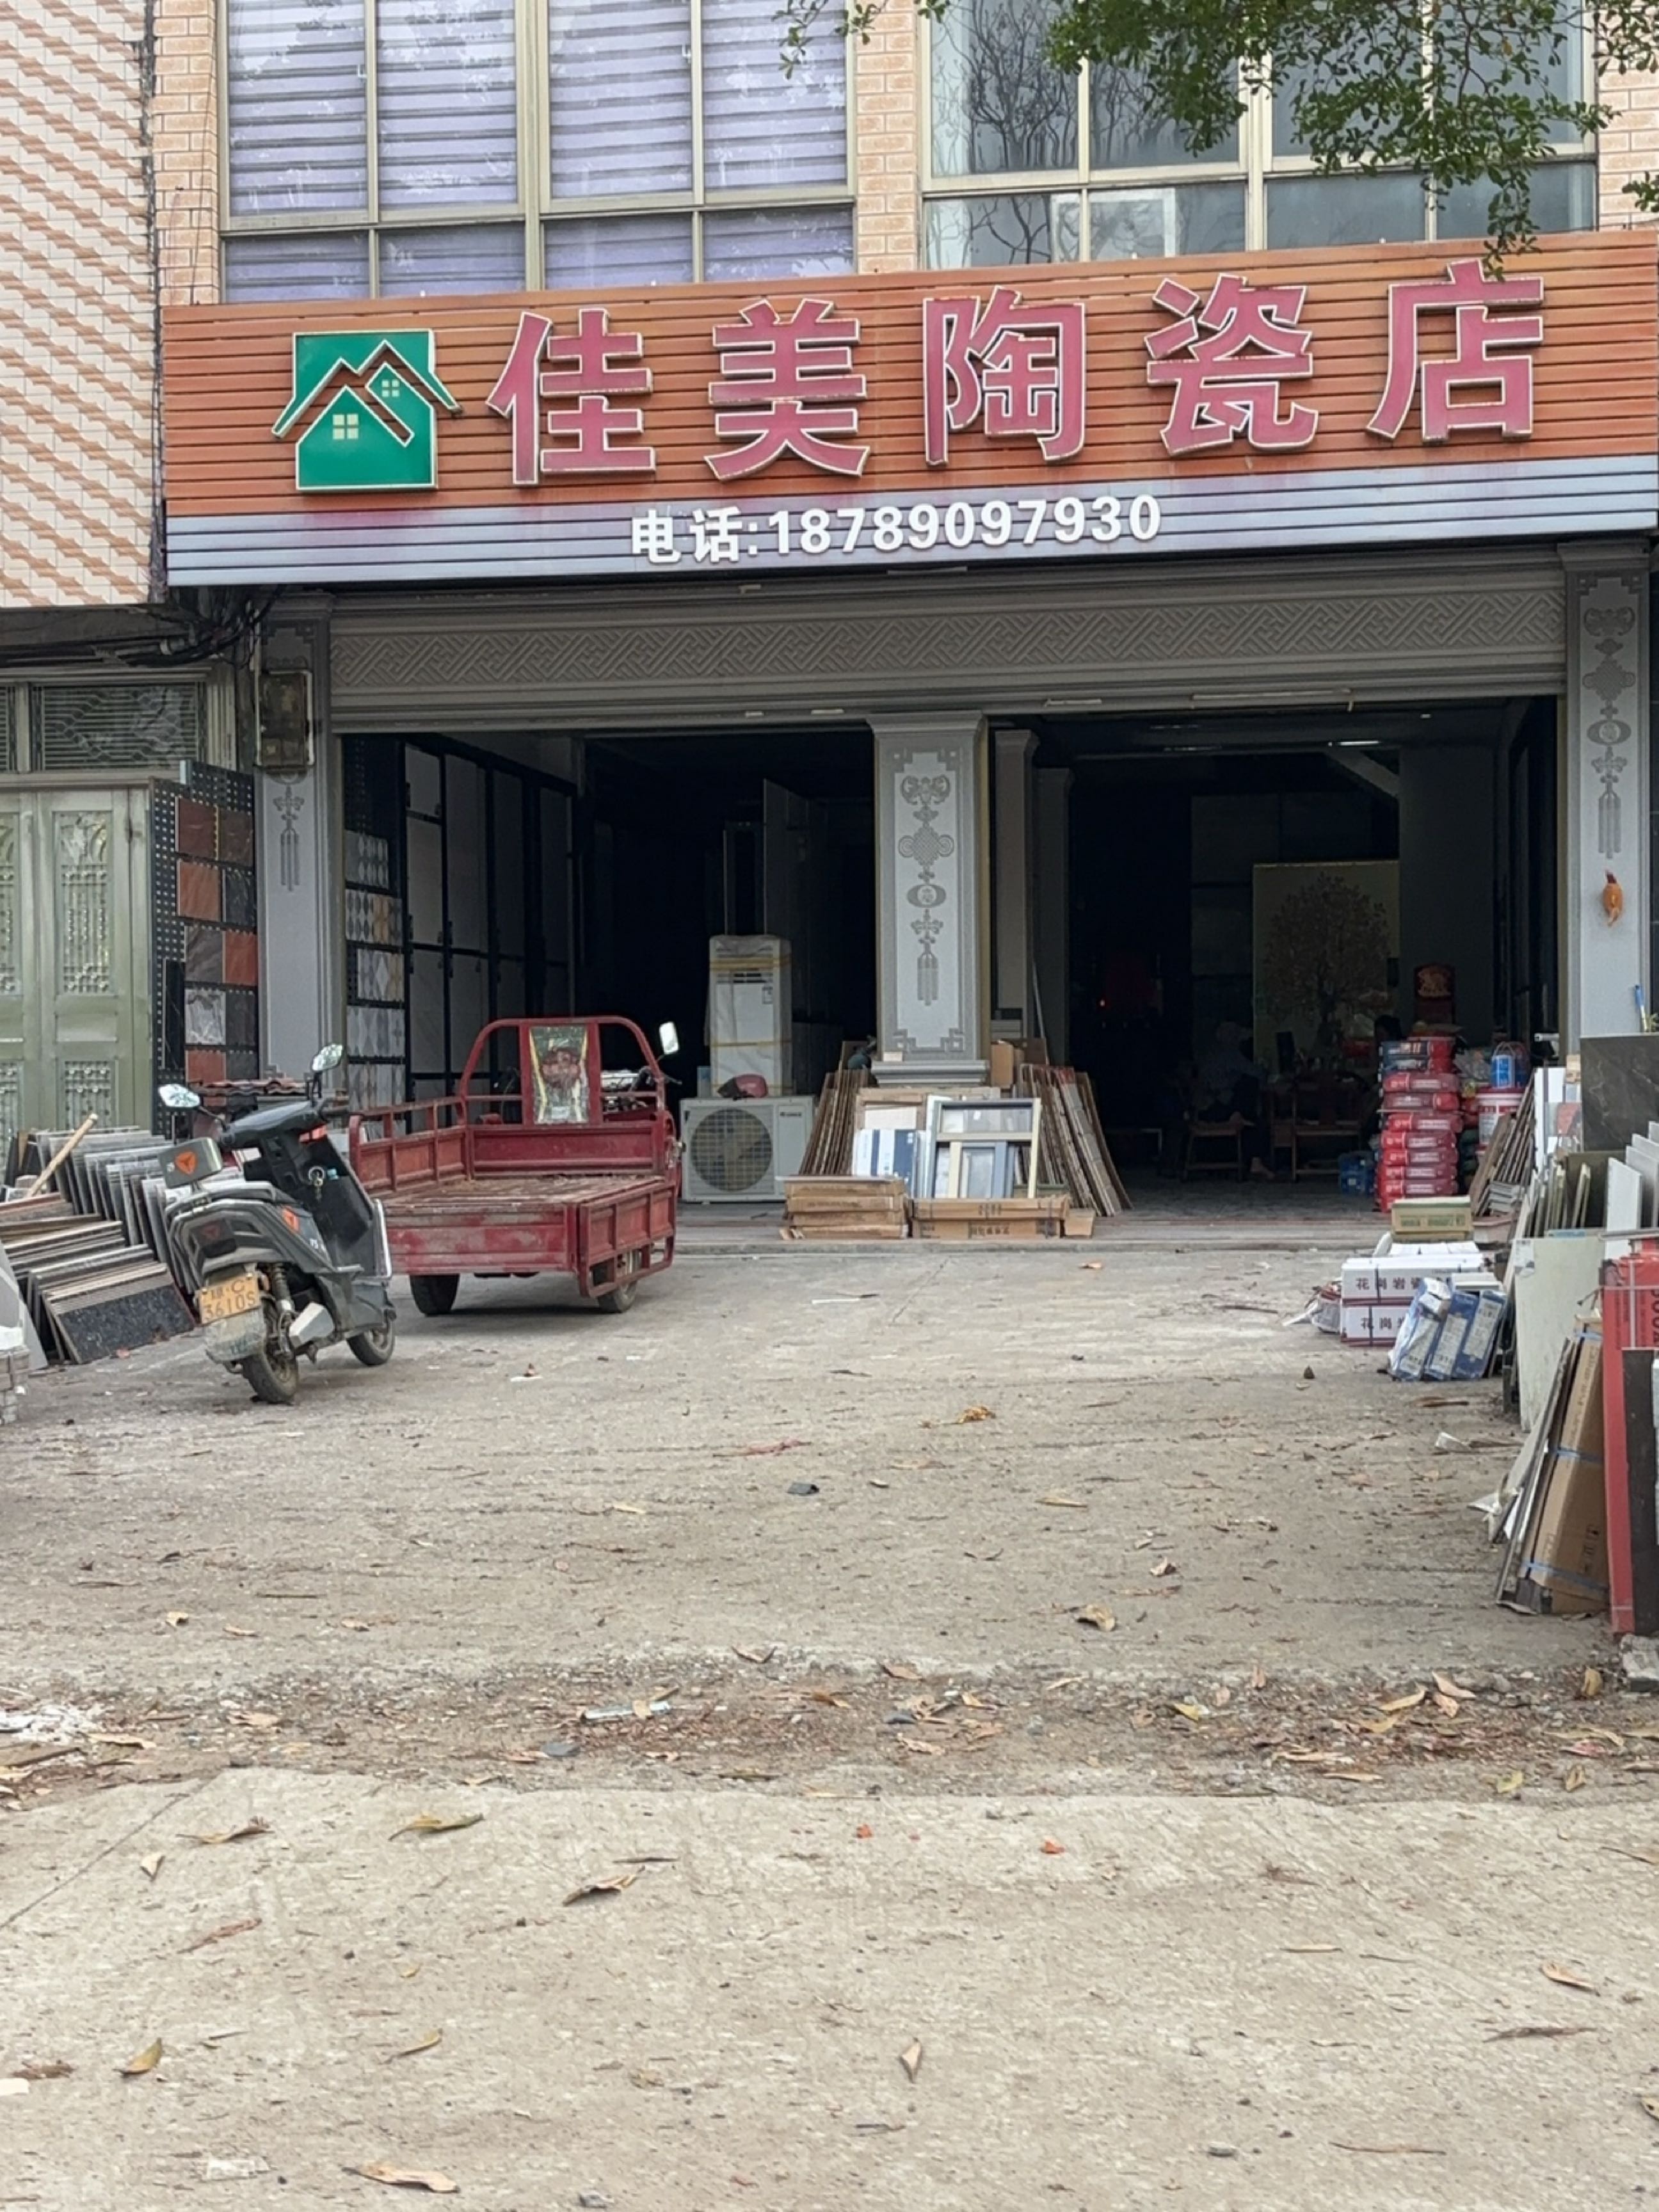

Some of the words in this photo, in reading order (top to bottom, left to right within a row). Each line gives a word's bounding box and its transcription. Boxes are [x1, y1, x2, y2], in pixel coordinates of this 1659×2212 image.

[486, 258, 1544, 486] 佳美陶瓷店
[631, 493, 1162, 564] 电话:18789097930
